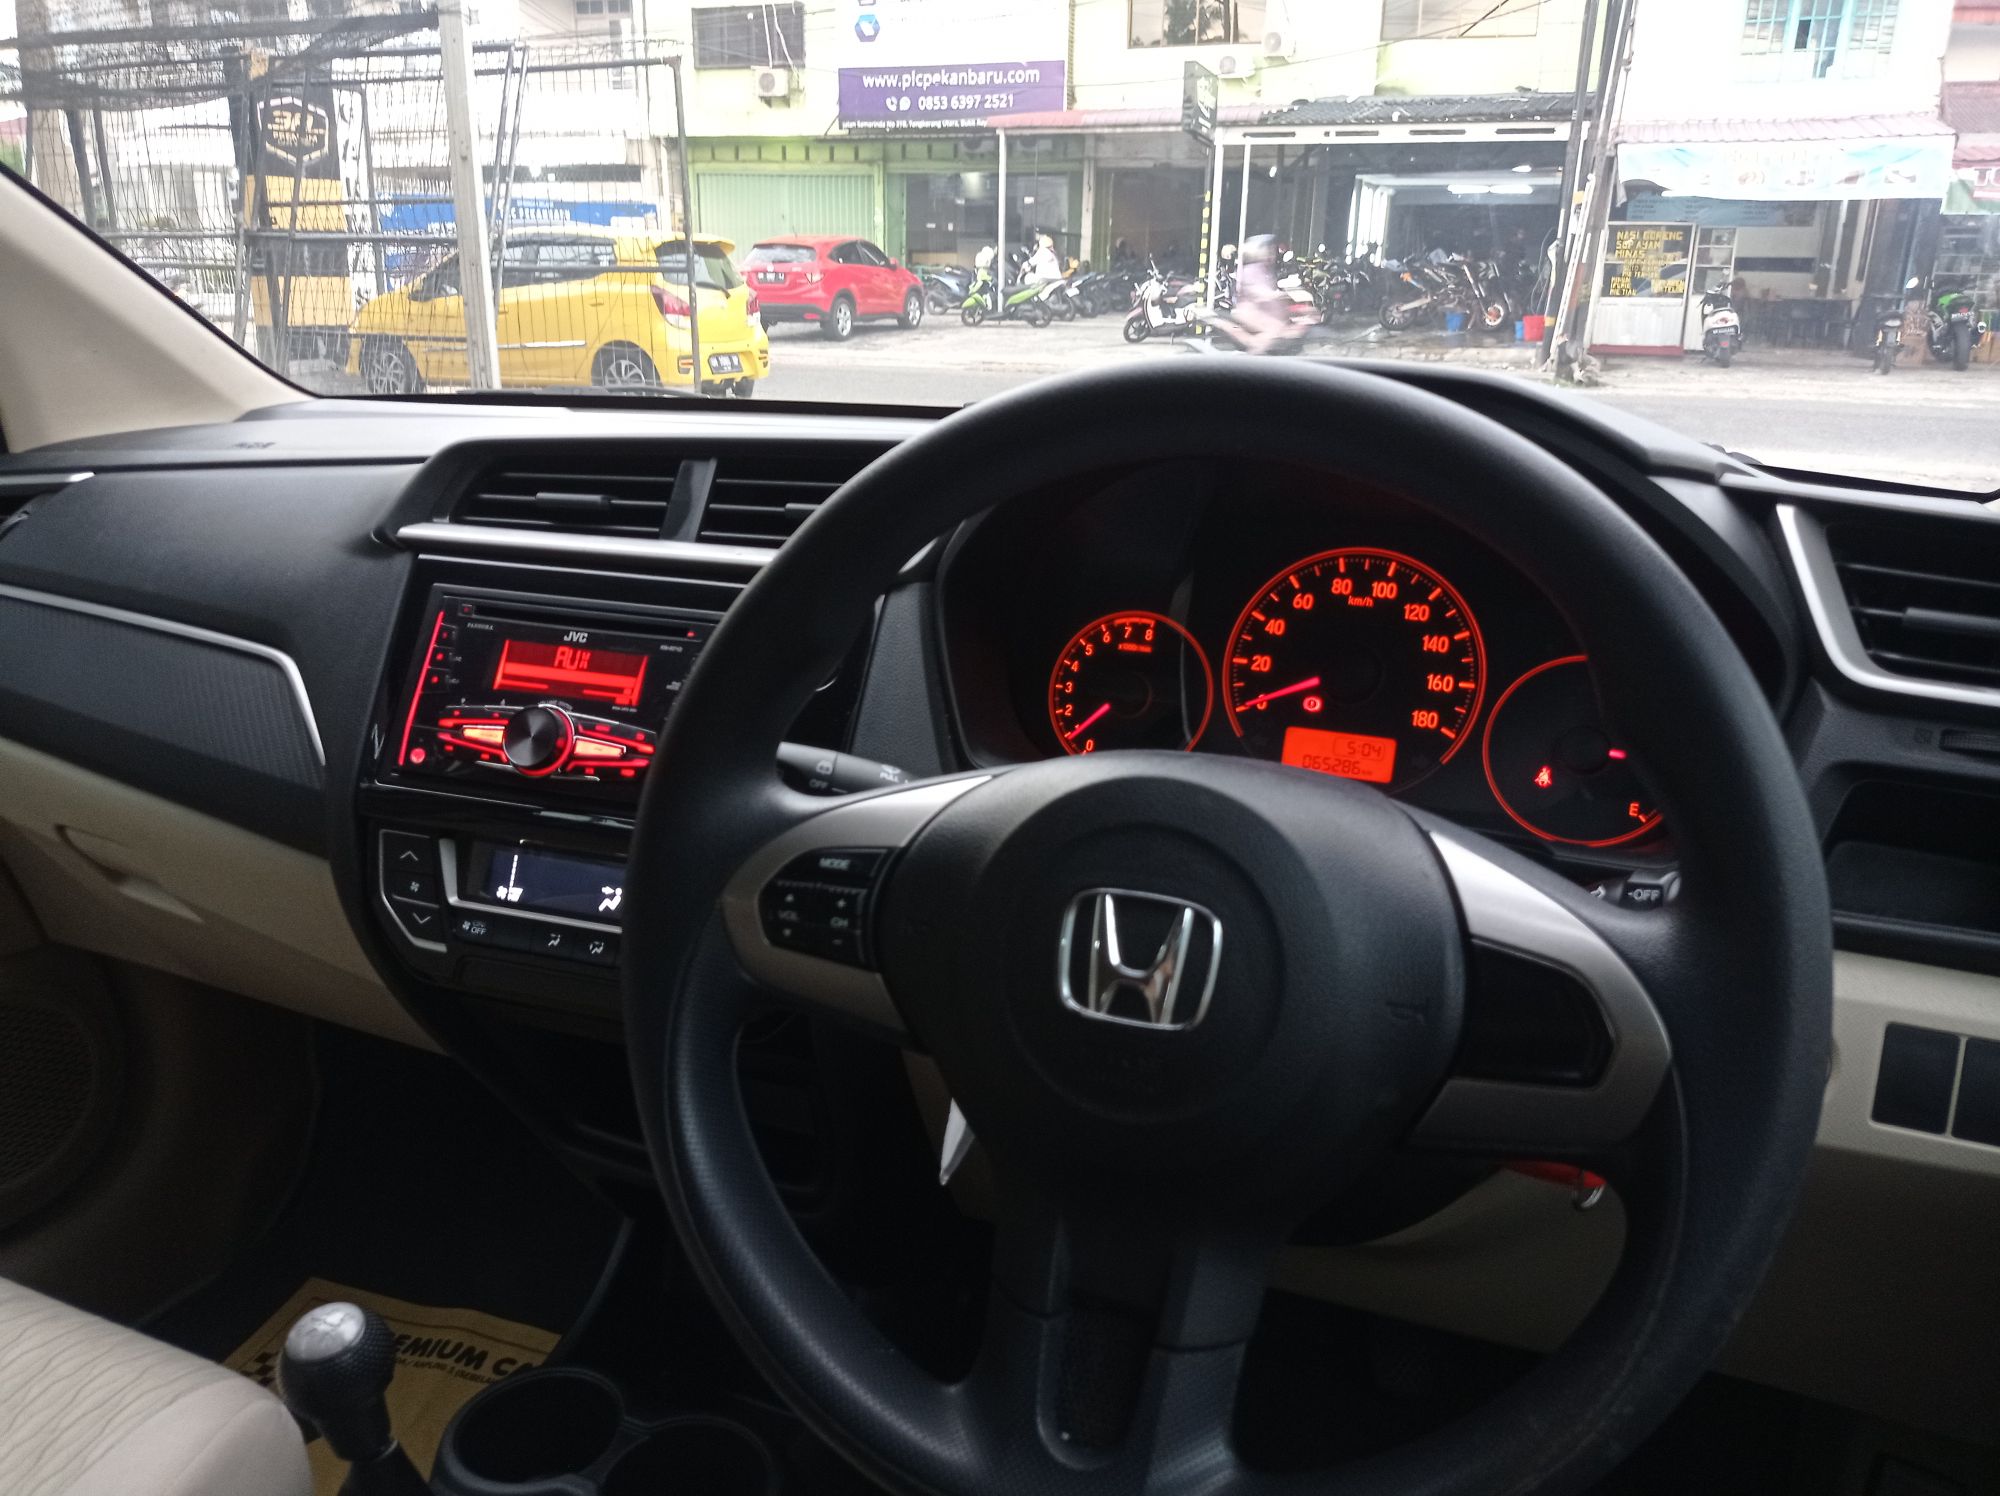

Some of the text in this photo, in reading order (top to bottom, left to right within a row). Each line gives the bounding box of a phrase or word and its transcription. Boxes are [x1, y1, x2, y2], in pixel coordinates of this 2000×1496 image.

[863, 68, 1041, 91] www.plcpekanbaru.com
[917, 93, 1015, 111] 0853 6397 2521
[1616, 231, 1640, 241] NASI
[1635, 240, 1661, 250] AYAM
[1331, 578, 1353, 595] 80
[1371, 582, 1398, 599] 100
[1292, 593, 1314, 610] 60
[1347, 596, 1374, 608] km/h
[1403, 604, 1430, 622] 120
[1123, 626, 1132, 639] 7
[1264, 619, 1286, 636] 40
[563, 630, 588, 643] JVC
[1103, 631, 1111, 644] 6
[1144, 628, 1153, 641] 8
[1084, 644, 1094, 657] 5
[1422, 635, 1449, 653] 140
[554, 645, 591, 671] AUX
[1250, 655, 1272, 672] 20
[1070, 660, 1080, 672] 4
[1064, 682, 1073, 694] 3
[1426, 674, 1454, 692] 160
[1064, 704, 1073, 717] 2
[1411, 709, 1439, 729] 180
[1085, 739, 1095, 752] 0
[1346, 741, 1383, 758] 5:04
[1302, 753, 1361, 775] 065286
[1629, 803, 1640, 816] E
[819, 858, 851, 870] MODE
[1633, 889, 1660, 900] OFF
[830, 916, 849, 928] CH
[471, 927, 487, 935] OFF
[392, 1334, 489, 1371] EMIUM
